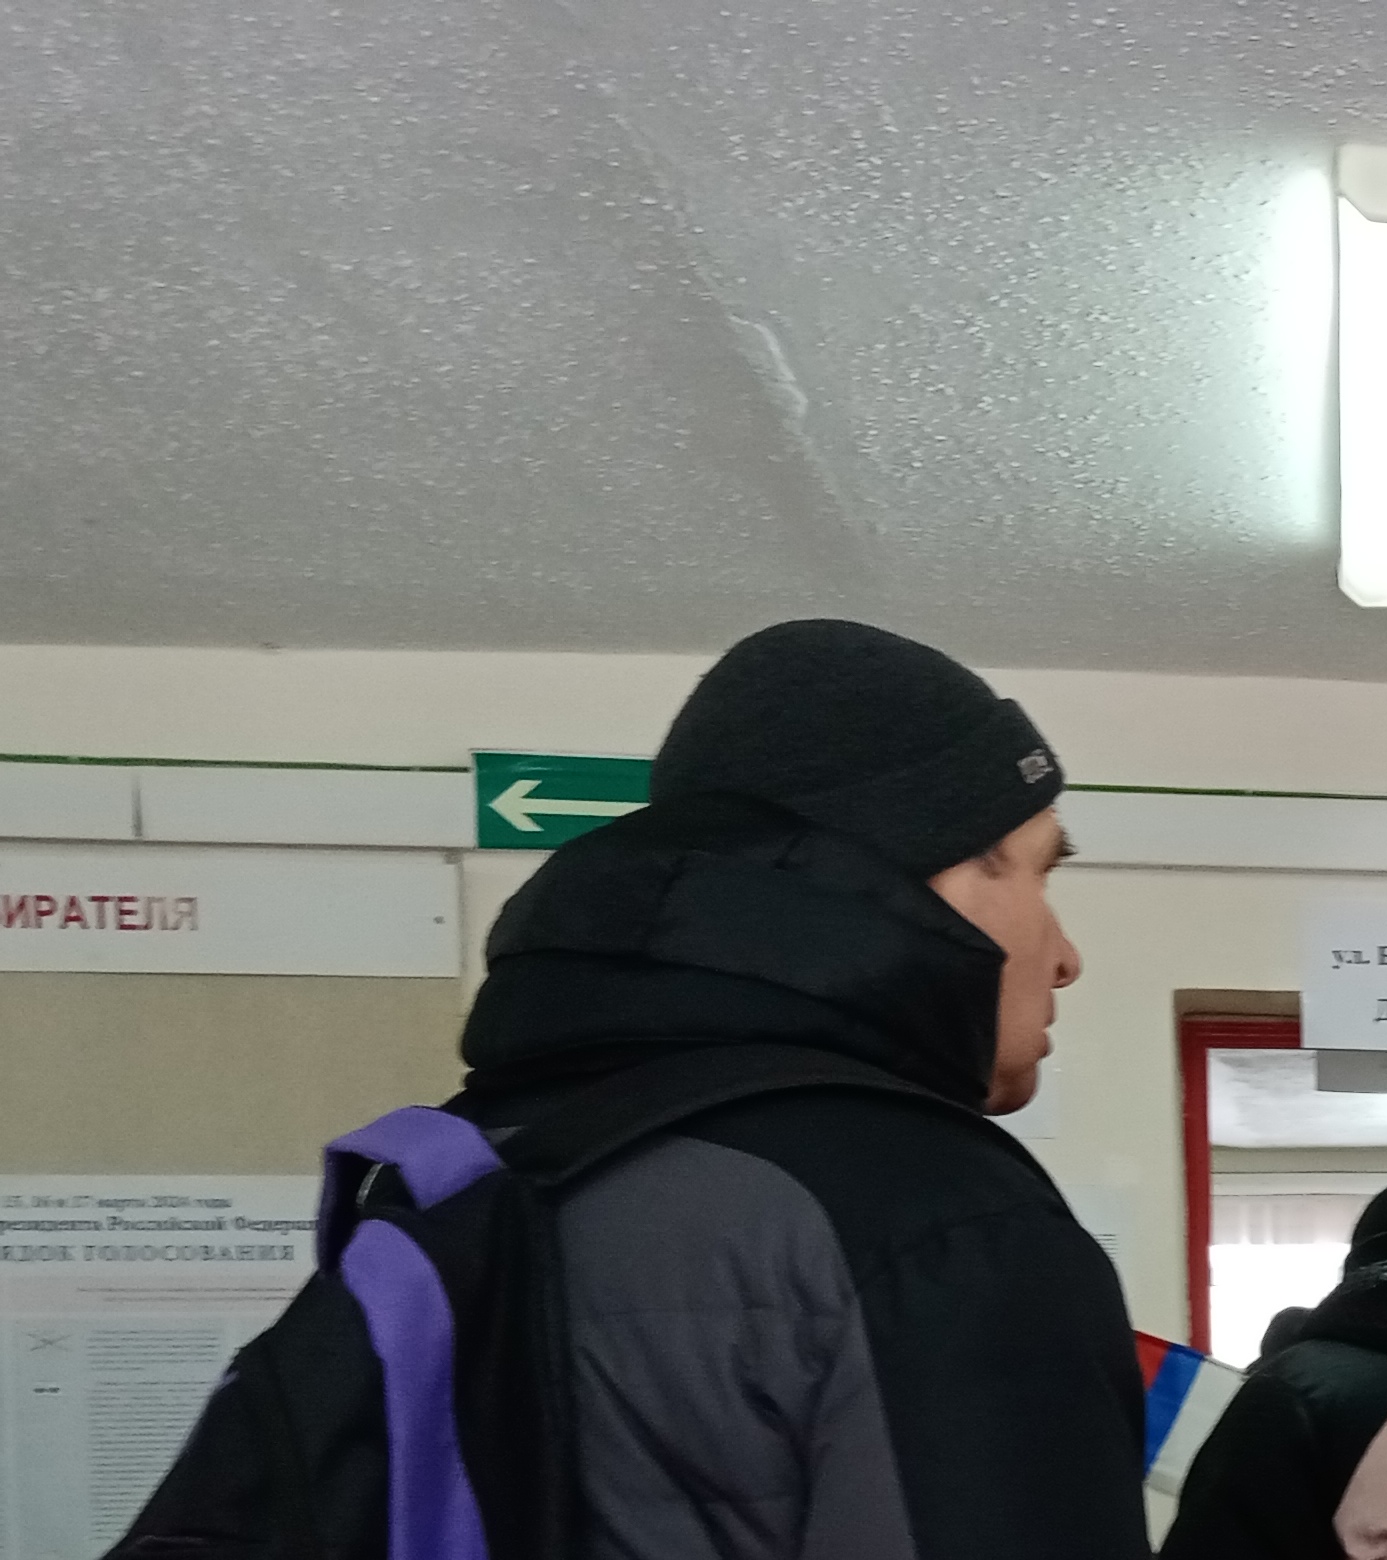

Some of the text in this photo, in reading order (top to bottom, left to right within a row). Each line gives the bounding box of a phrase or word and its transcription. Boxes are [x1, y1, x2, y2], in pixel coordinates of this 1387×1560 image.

[0, 894, 199, 931] ИРАТЕЛЯ
[1331, 950, 1371, 969] ул.
[81, 1244, 295, 1262] ГОЛОСОВАНИЯ
